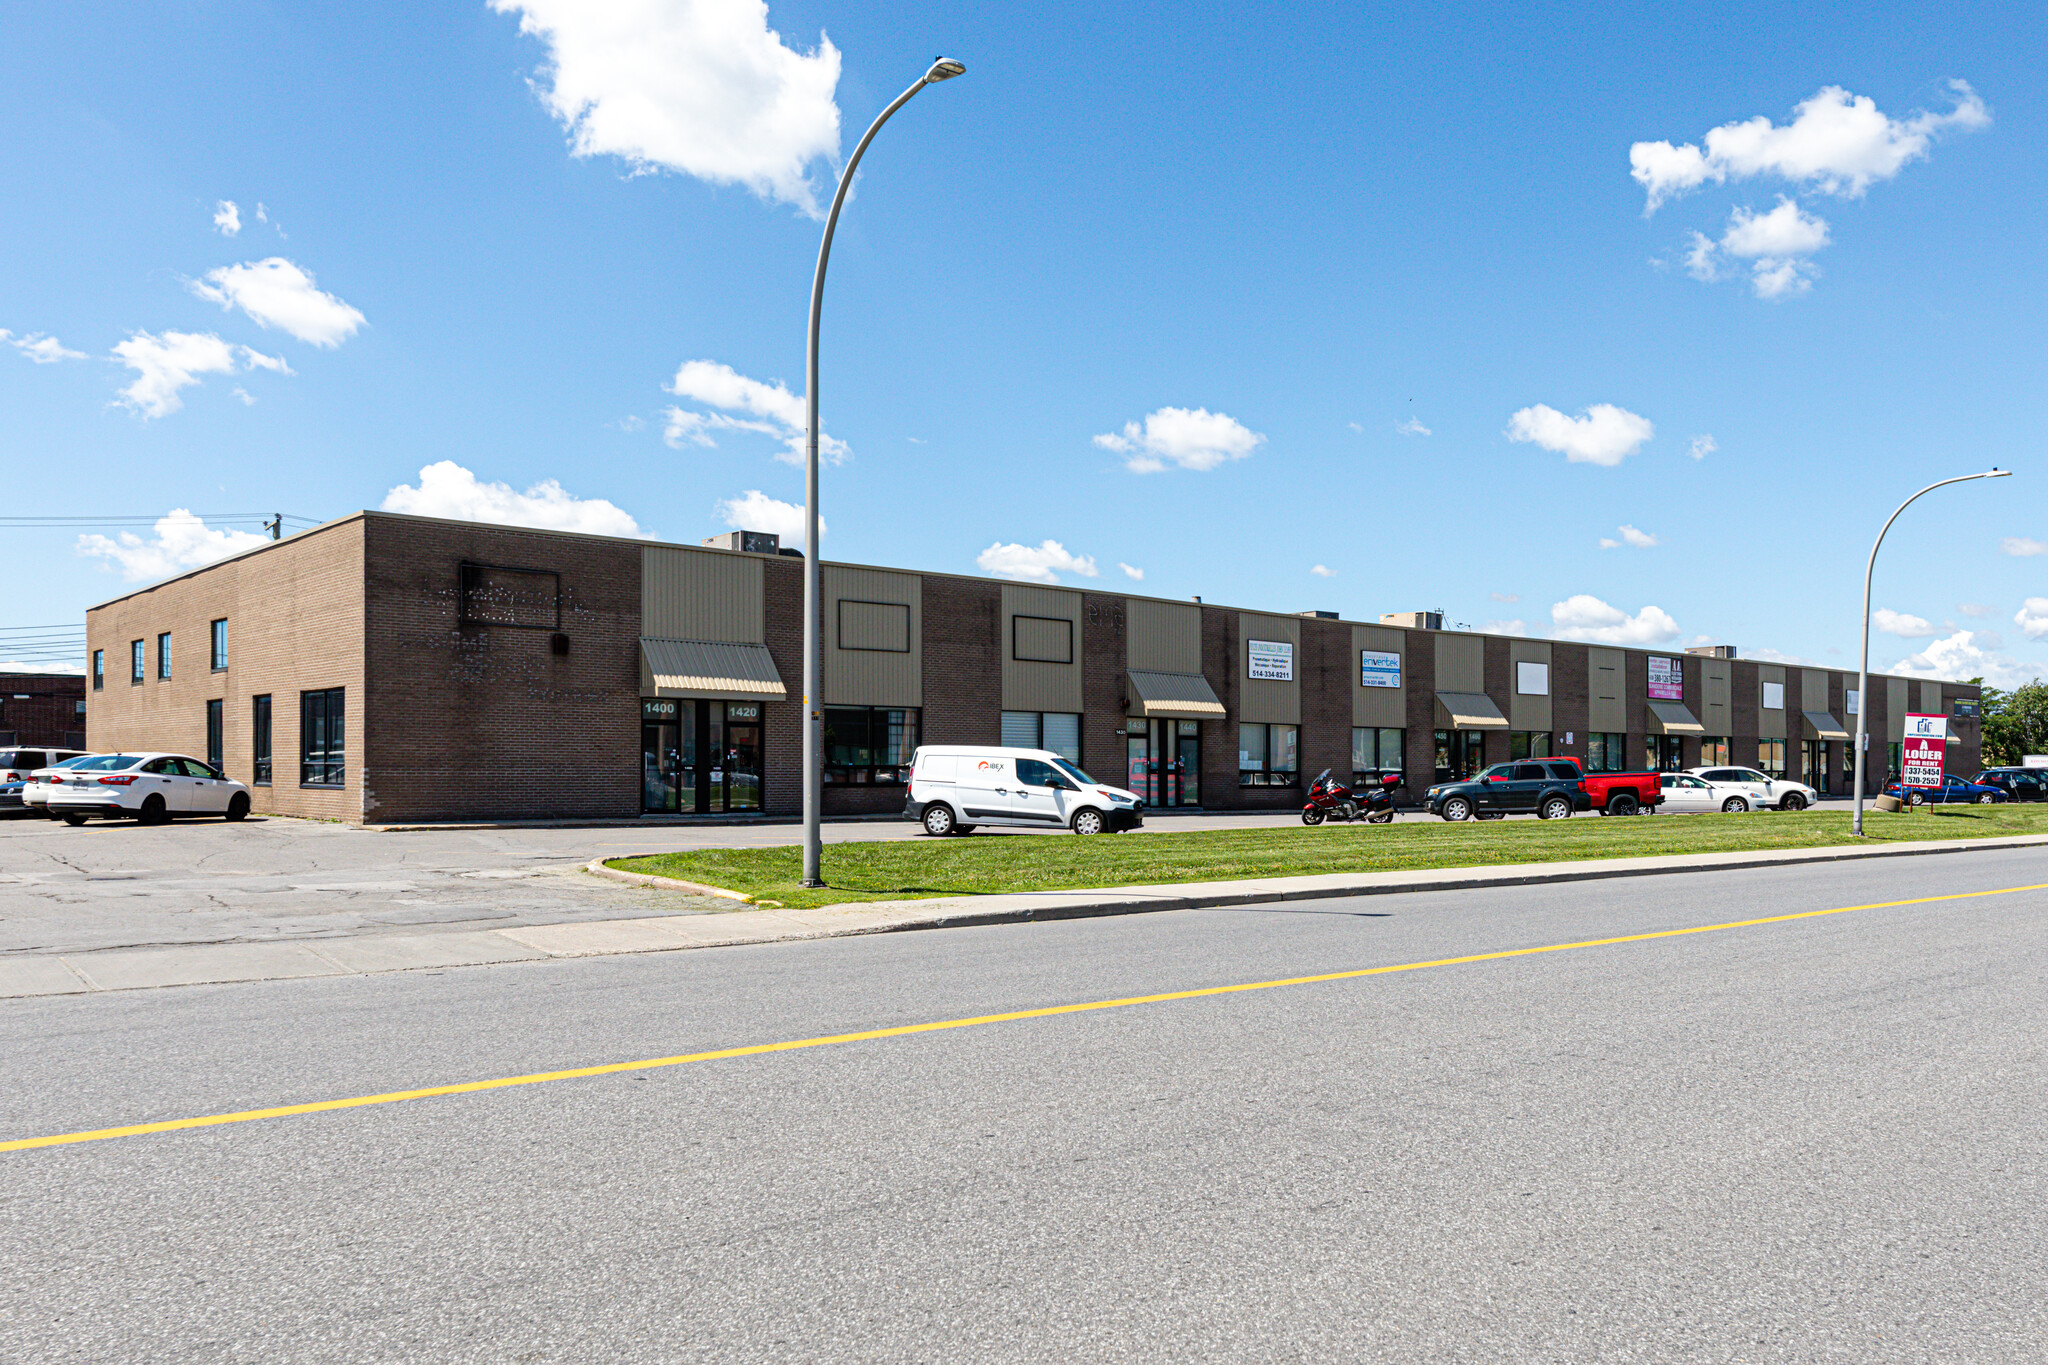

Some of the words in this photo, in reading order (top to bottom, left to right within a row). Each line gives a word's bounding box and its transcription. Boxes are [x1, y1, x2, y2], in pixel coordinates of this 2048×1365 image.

[1363, 656, 1399, 667] envertek
[1252, 670, 1289, 678] 514-334-8211
[645, 703, 674, 713] 1400
[730, 707, 757, 717] 1420
[1128, 721, 1146, 729] 1430
[1180, 723, 1196, 731] 1440
[1905, 749, 1942, 761] LOUER
[1908, 767, 1940, 776] 337-5454
[1907, 776, 1940, 785] 570-2557
